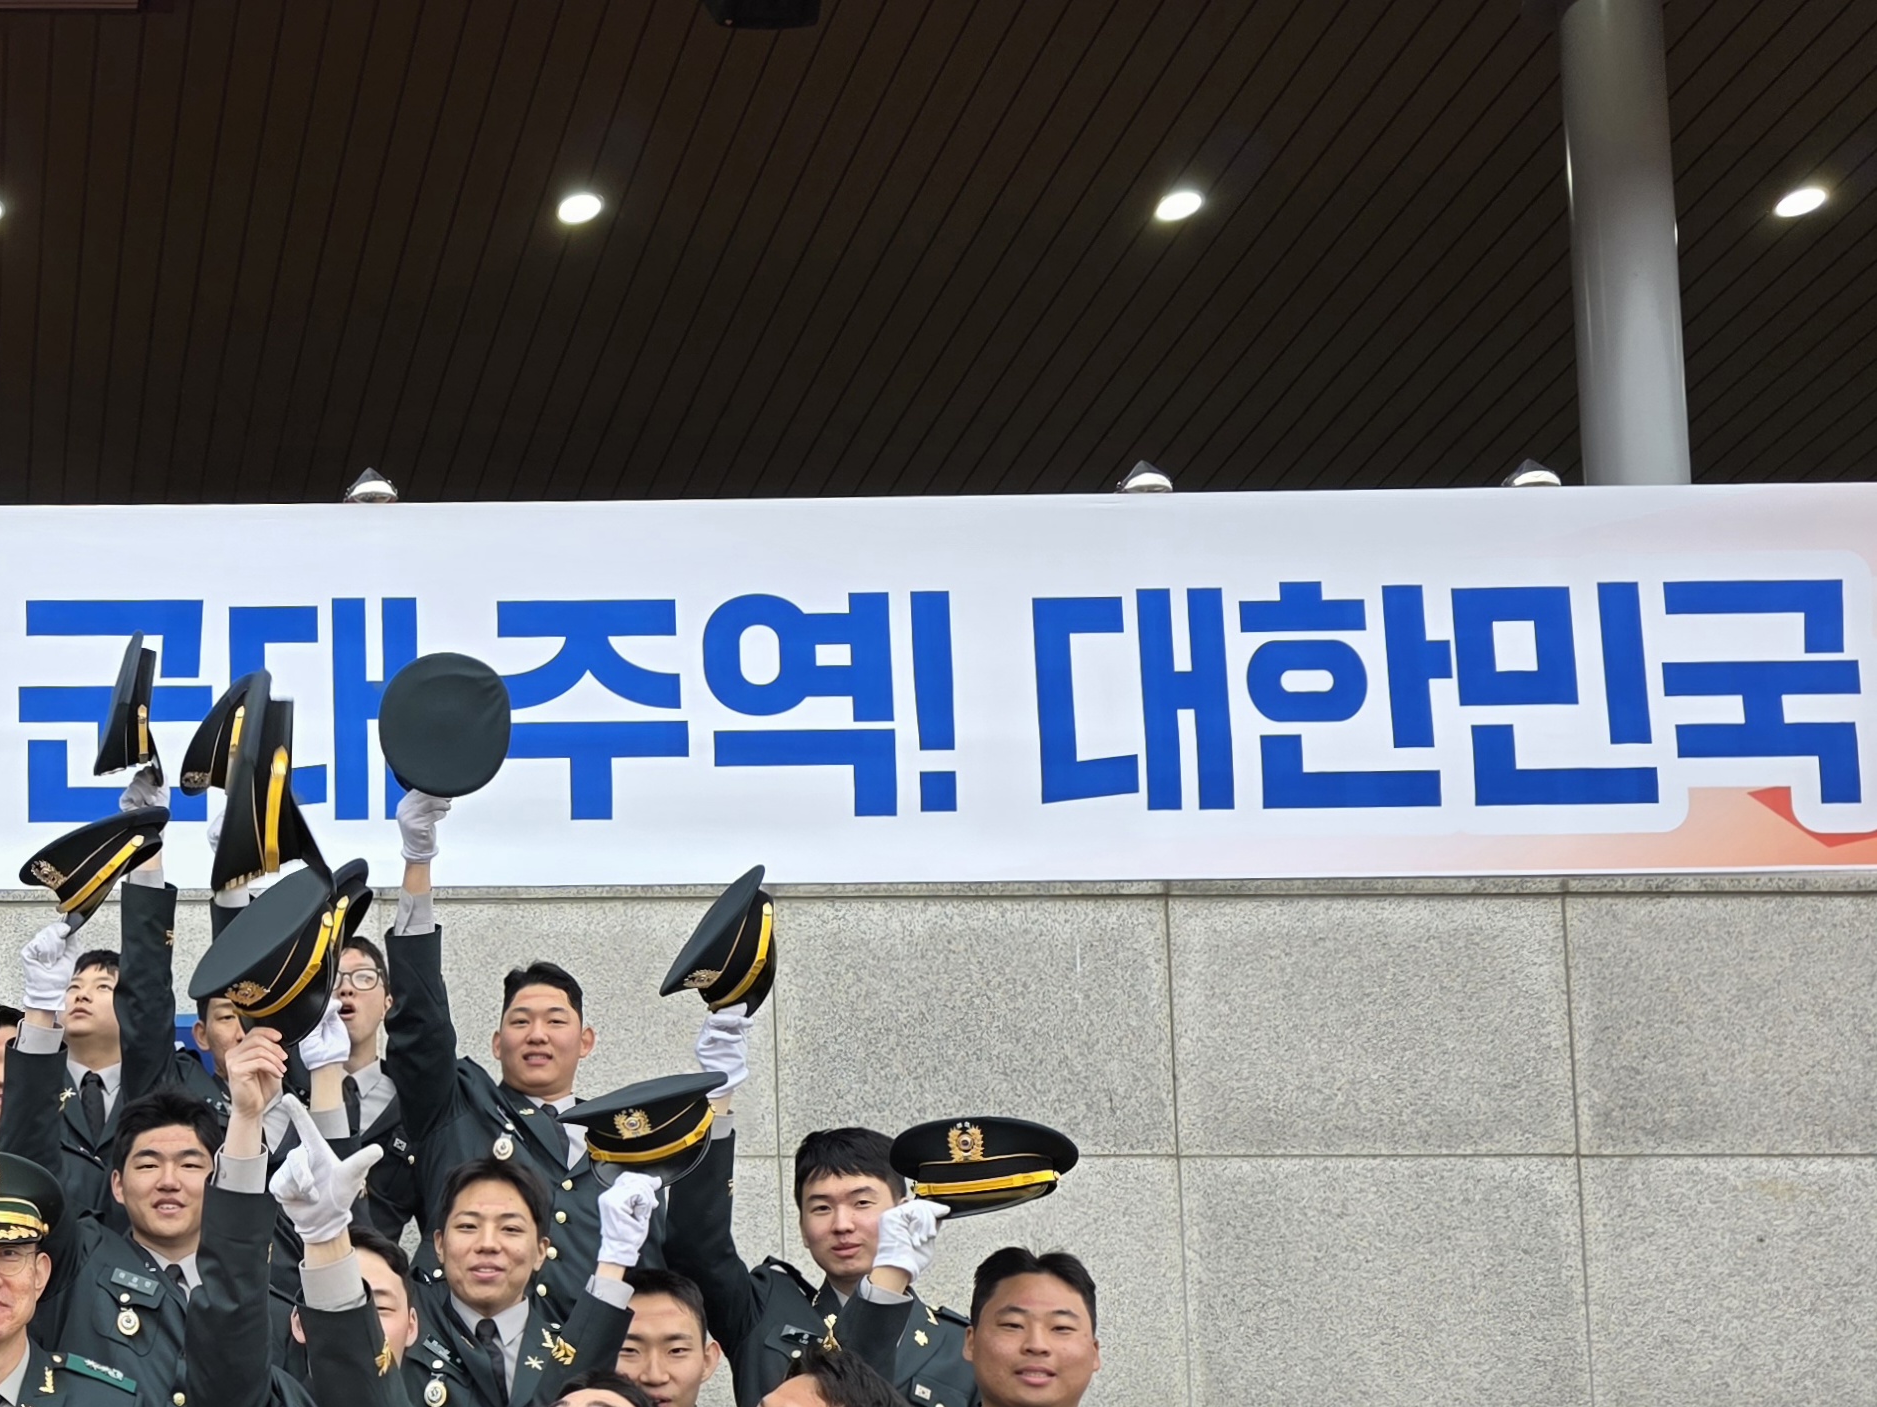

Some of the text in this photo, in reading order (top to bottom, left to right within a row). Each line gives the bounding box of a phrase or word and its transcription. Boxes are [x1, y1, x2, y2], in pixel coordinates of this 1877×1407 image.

[19, 597, 418, 824] 군대
[496, 590, 957, 821] 주역!
[1032, 580, 1861, 811] 대한민국
